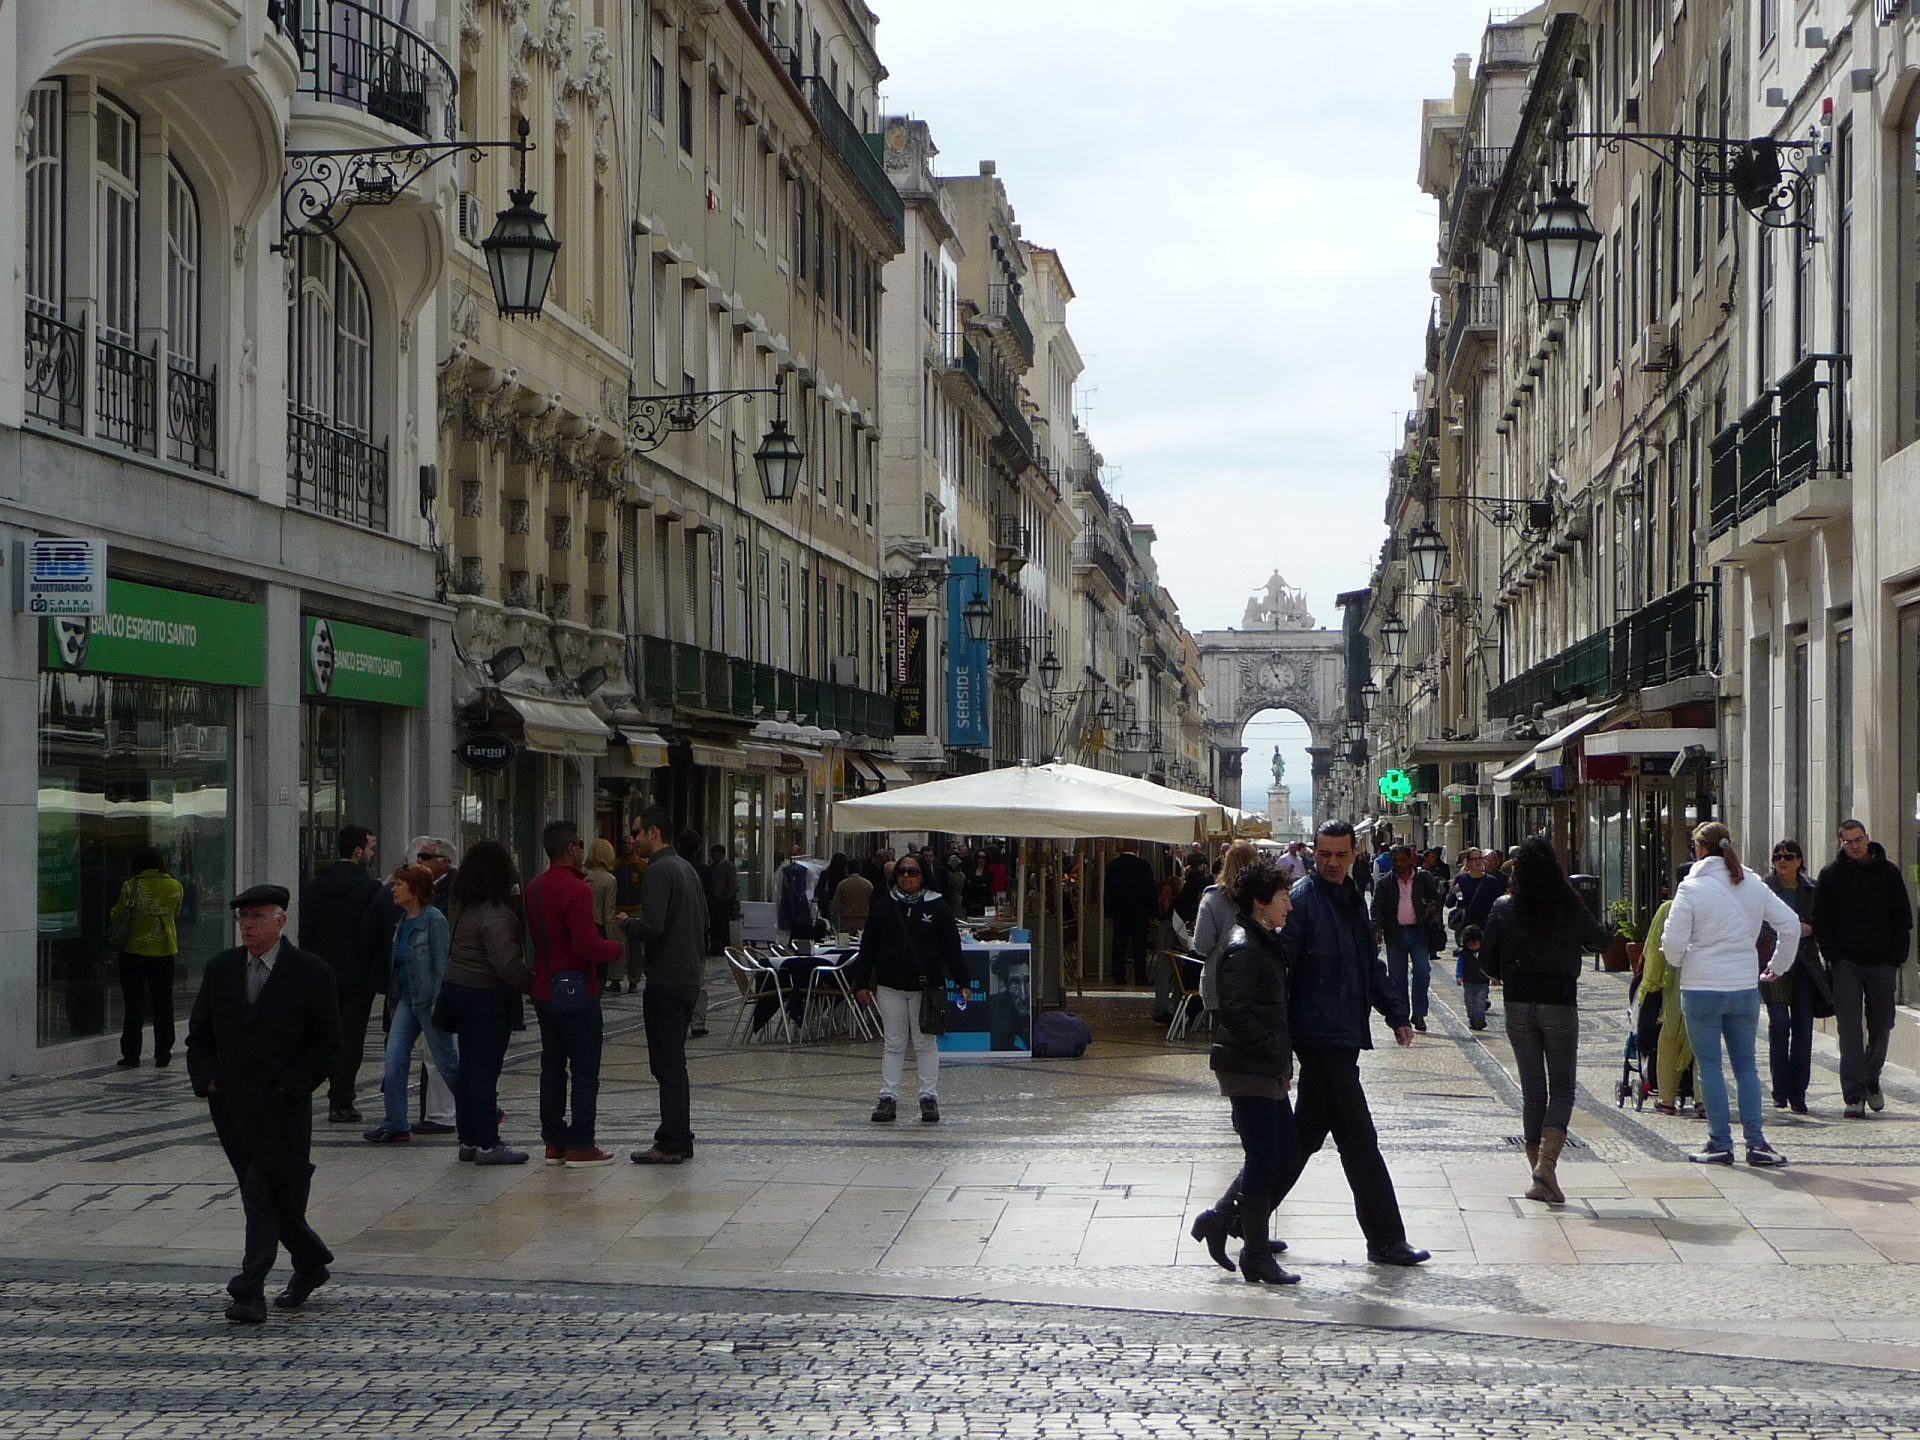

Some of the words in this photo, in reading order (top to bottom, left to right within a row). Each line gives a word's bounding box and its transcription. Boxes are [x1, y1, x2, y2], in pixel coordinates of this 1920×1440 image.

[31, 583, 93, 593] MULTIBANCO
[91, 613, 124, 638] BANCO
[167, 622, 197, 647] SANTO
[957, 666, 970, 728] SEASIDE
[467, 744, 506, 758] Farggi
